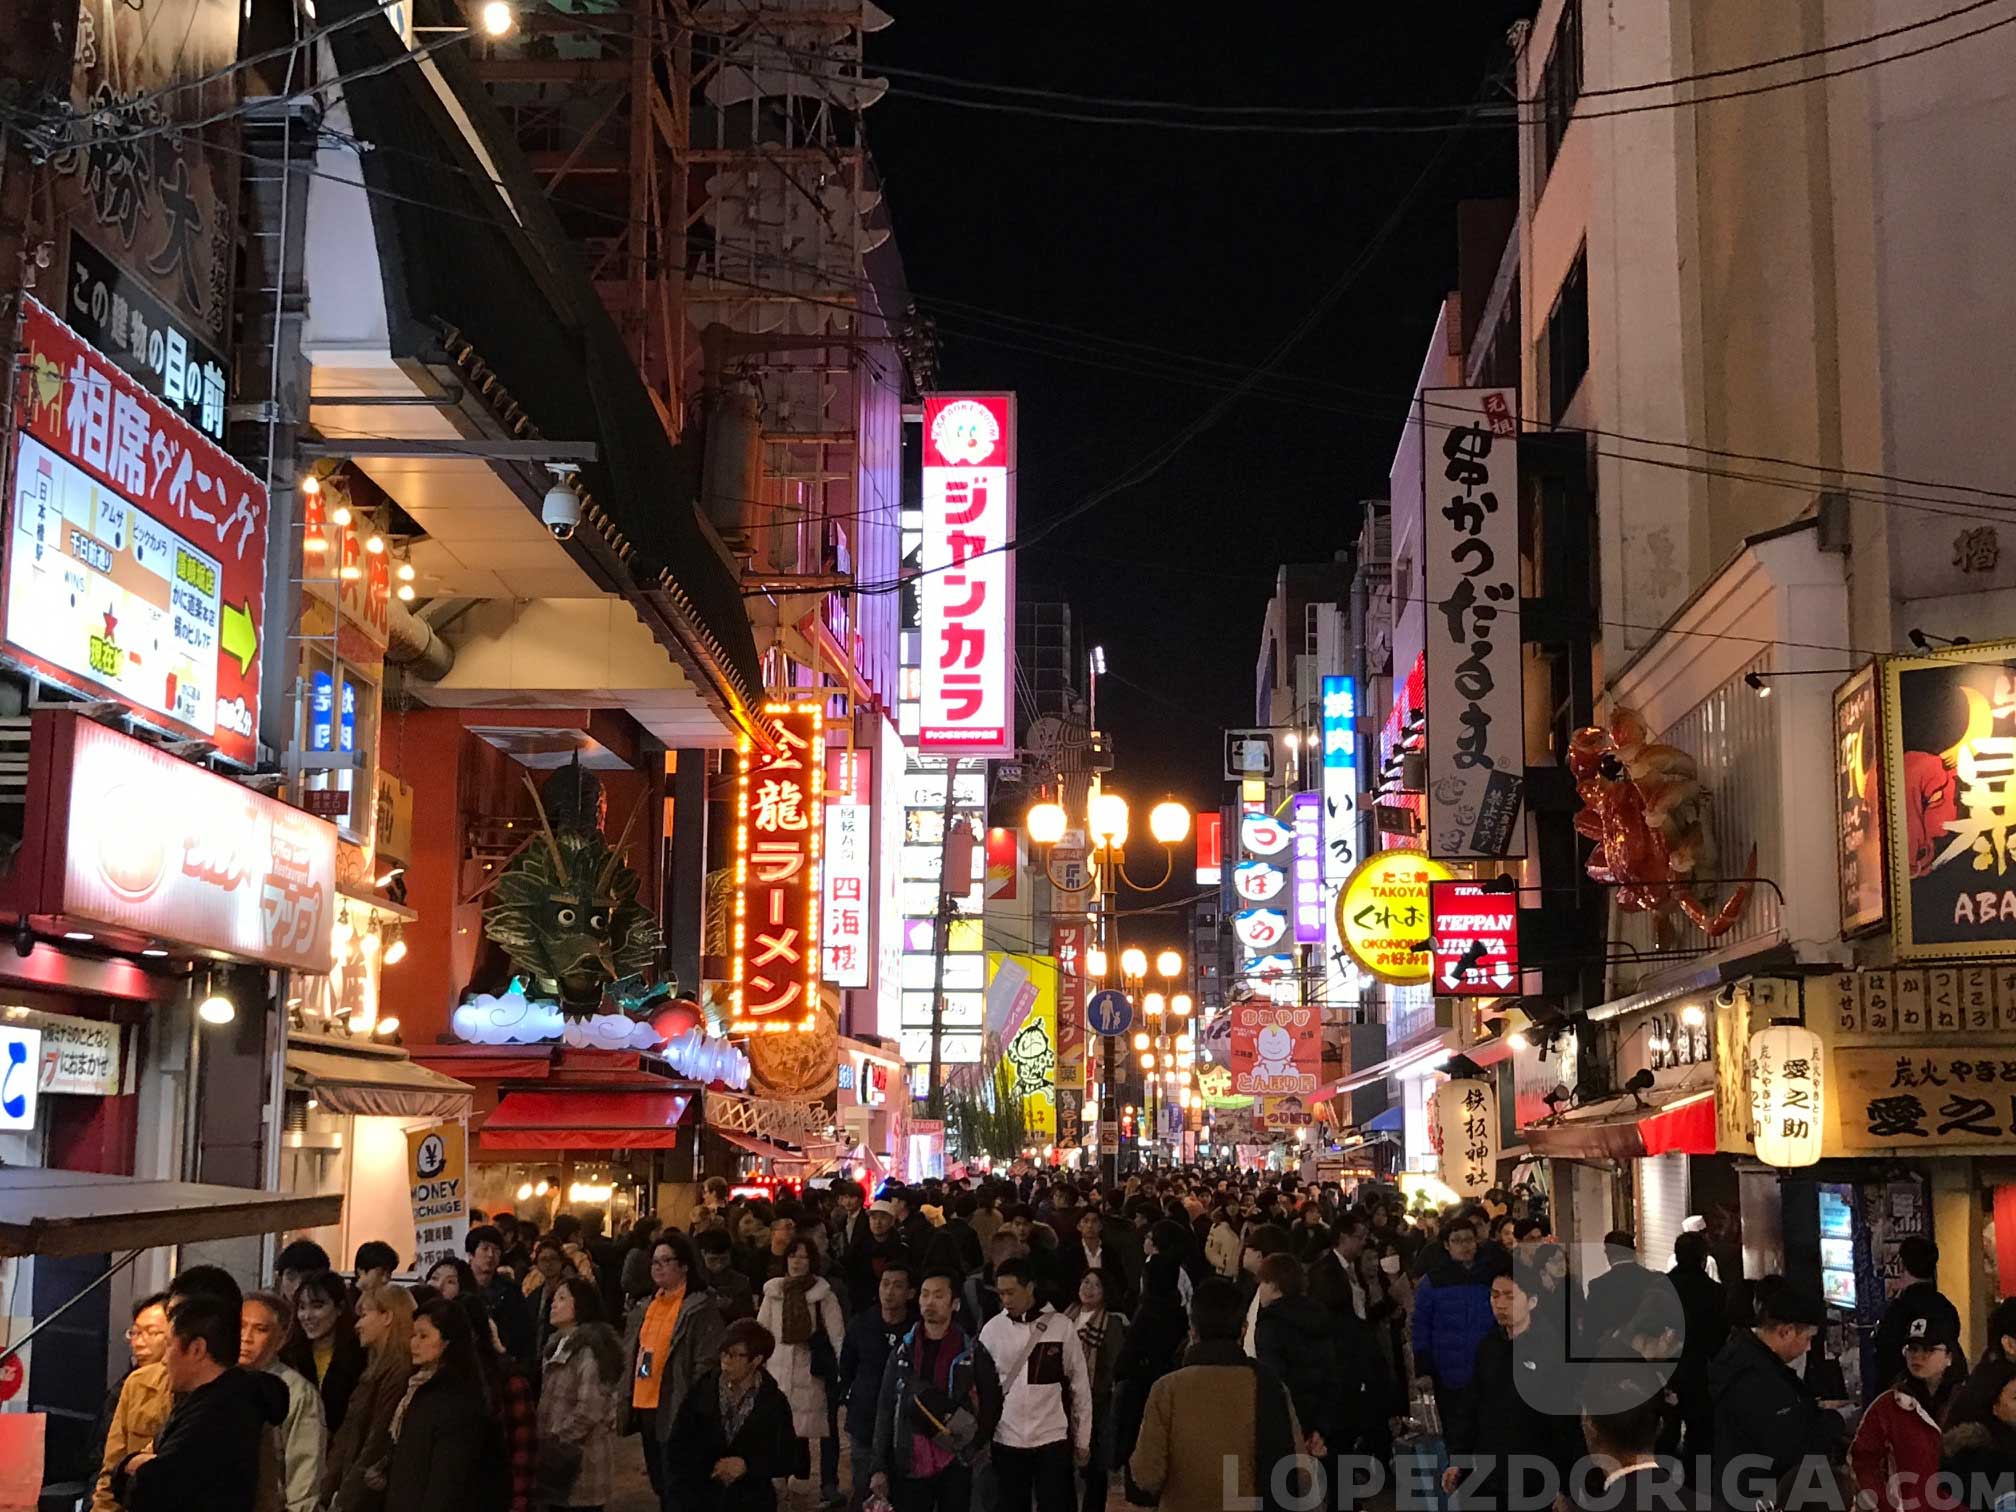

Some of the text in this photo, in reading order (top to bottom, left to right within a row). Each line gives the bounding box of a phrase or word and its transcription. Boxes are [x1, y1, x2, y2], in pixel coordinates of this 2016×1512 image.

[73, 261, 226, 439] この建物の目の前
[66, 354, 261, 560] 相席ダイニング
[940, 476, 987, 721] ジャンカラ
[1438, 421, 1515, 770] 串かつだるま
[1324, 690, 1354, 756] 焼肉
[750, 718, 809, 1015] 金龍ラーメン
[1437, 914, 1514, 932] TEPPAN
[1059, 928, 1077, 1043] ツルハドラッグ
[1465, 968, 1488, 985] B1
[1838, 976, 1855, 1030] せせり
[1869, 974, 1887, 1028] はらみ
[1902, 977, 1919, 1025] かわ
[1935, 972, 1953, 1026] つくね
[1970, 971, 1987, 1026] こころ
[1782, 1058, 1810, 1139] 愛之助
[1866, 1094, 2016, 1137] 愛之
[1463, 1088, 1489, 1187] 鉄板神社
